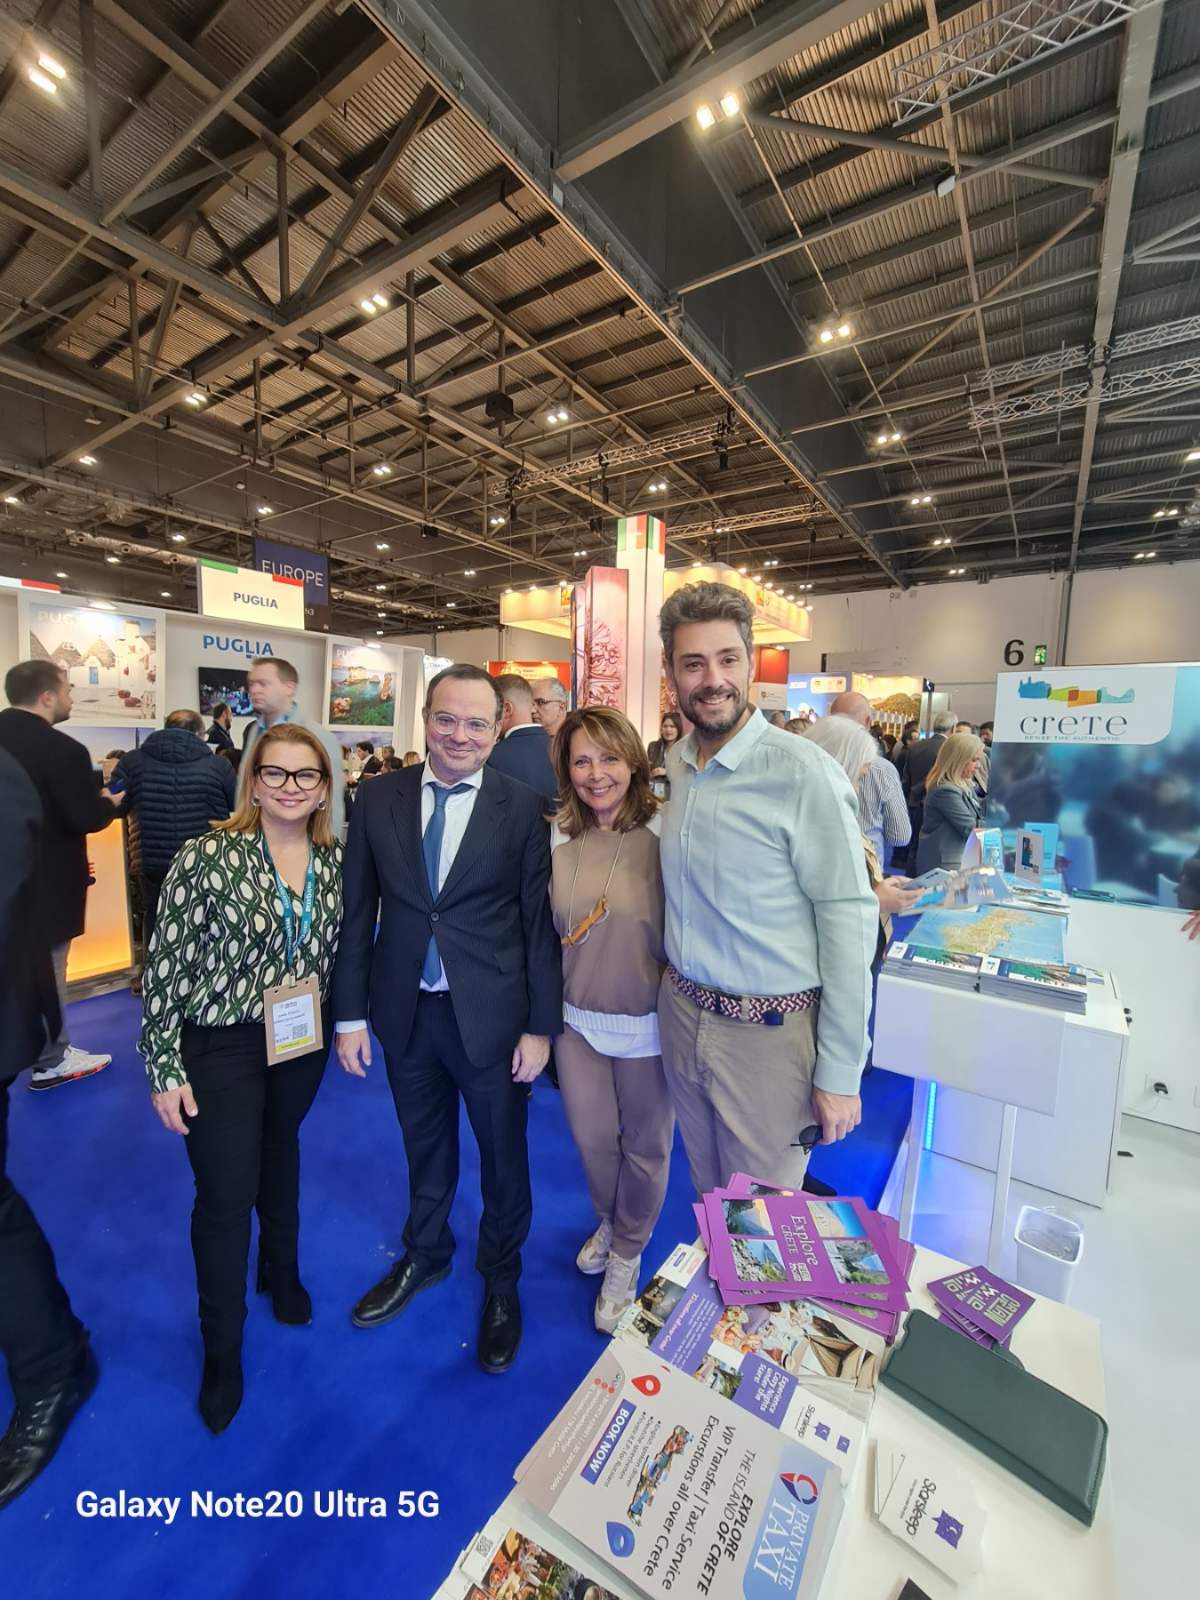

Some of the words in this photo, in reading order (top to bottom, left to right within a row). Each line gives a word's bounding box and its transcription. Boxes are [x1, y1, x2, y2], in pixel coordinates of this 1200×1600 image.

[262, 559, 324, 587] EUROPE
[233, 592, 279, 609] PUGLIA
[203, 635, 274, 657] PUGLIA
[1004, 639, 1025, 666] 6
[780, 1224, 799, 1254] CRETE
[790, 1214, 818, 1267] Explore
[606, 1408, 629, 1442] BOOK
[722, 1426, 736, 1445] VIP
[590, 1441, 611, 1473] NOW
[700, 1446, 728, 1496] Transfer
[739, 1450, 756, 1474] THE
[677, 1483, 689, 1501] all
[724, 1472, 747, 1520] ISLAND
[905, 1478, 936, 1536] Starsleep
[663, 1501, 681, 1534] over
[685, 1505, 705, 1534] Taxi
[717, 1521, 729, 1544] OF
[724, 1494, 753, 1561] EXPLORE
[644, 1535, 669, 1576] Crete
[754, 1497, 796, 1583] TAXI
[778, 1508, 810, 1590] PRIVATE
[662, 1534, 692, 1590] Service
[697, 1544, 721, 1595] CRETE
